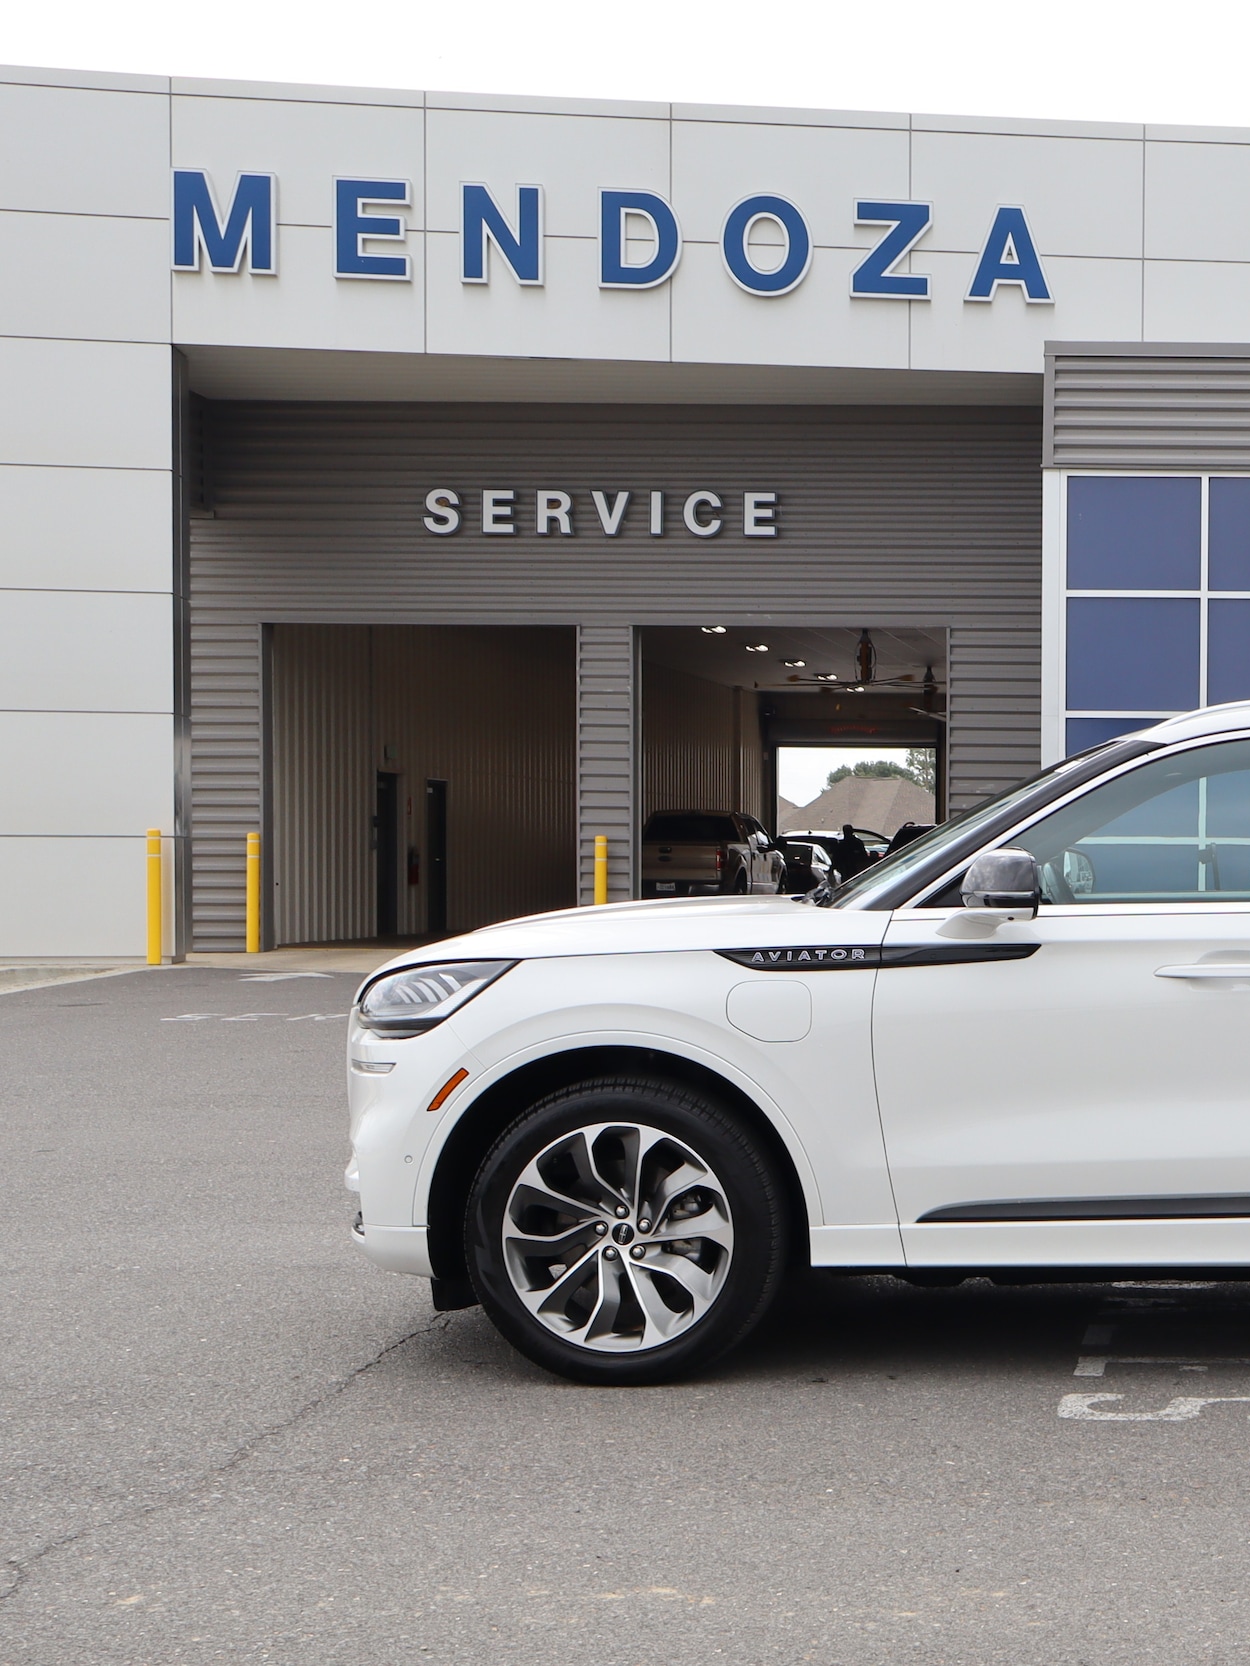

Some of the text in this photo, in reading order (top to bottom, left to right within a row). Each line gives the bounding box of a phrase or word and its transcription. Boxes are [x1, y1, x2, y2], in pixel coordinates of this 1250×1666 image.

[170, 167, 1055, 304] MENDOZA
[422, 488, 778, 538] SERVICE
[751, 949, 865, 963] AVIATOR
